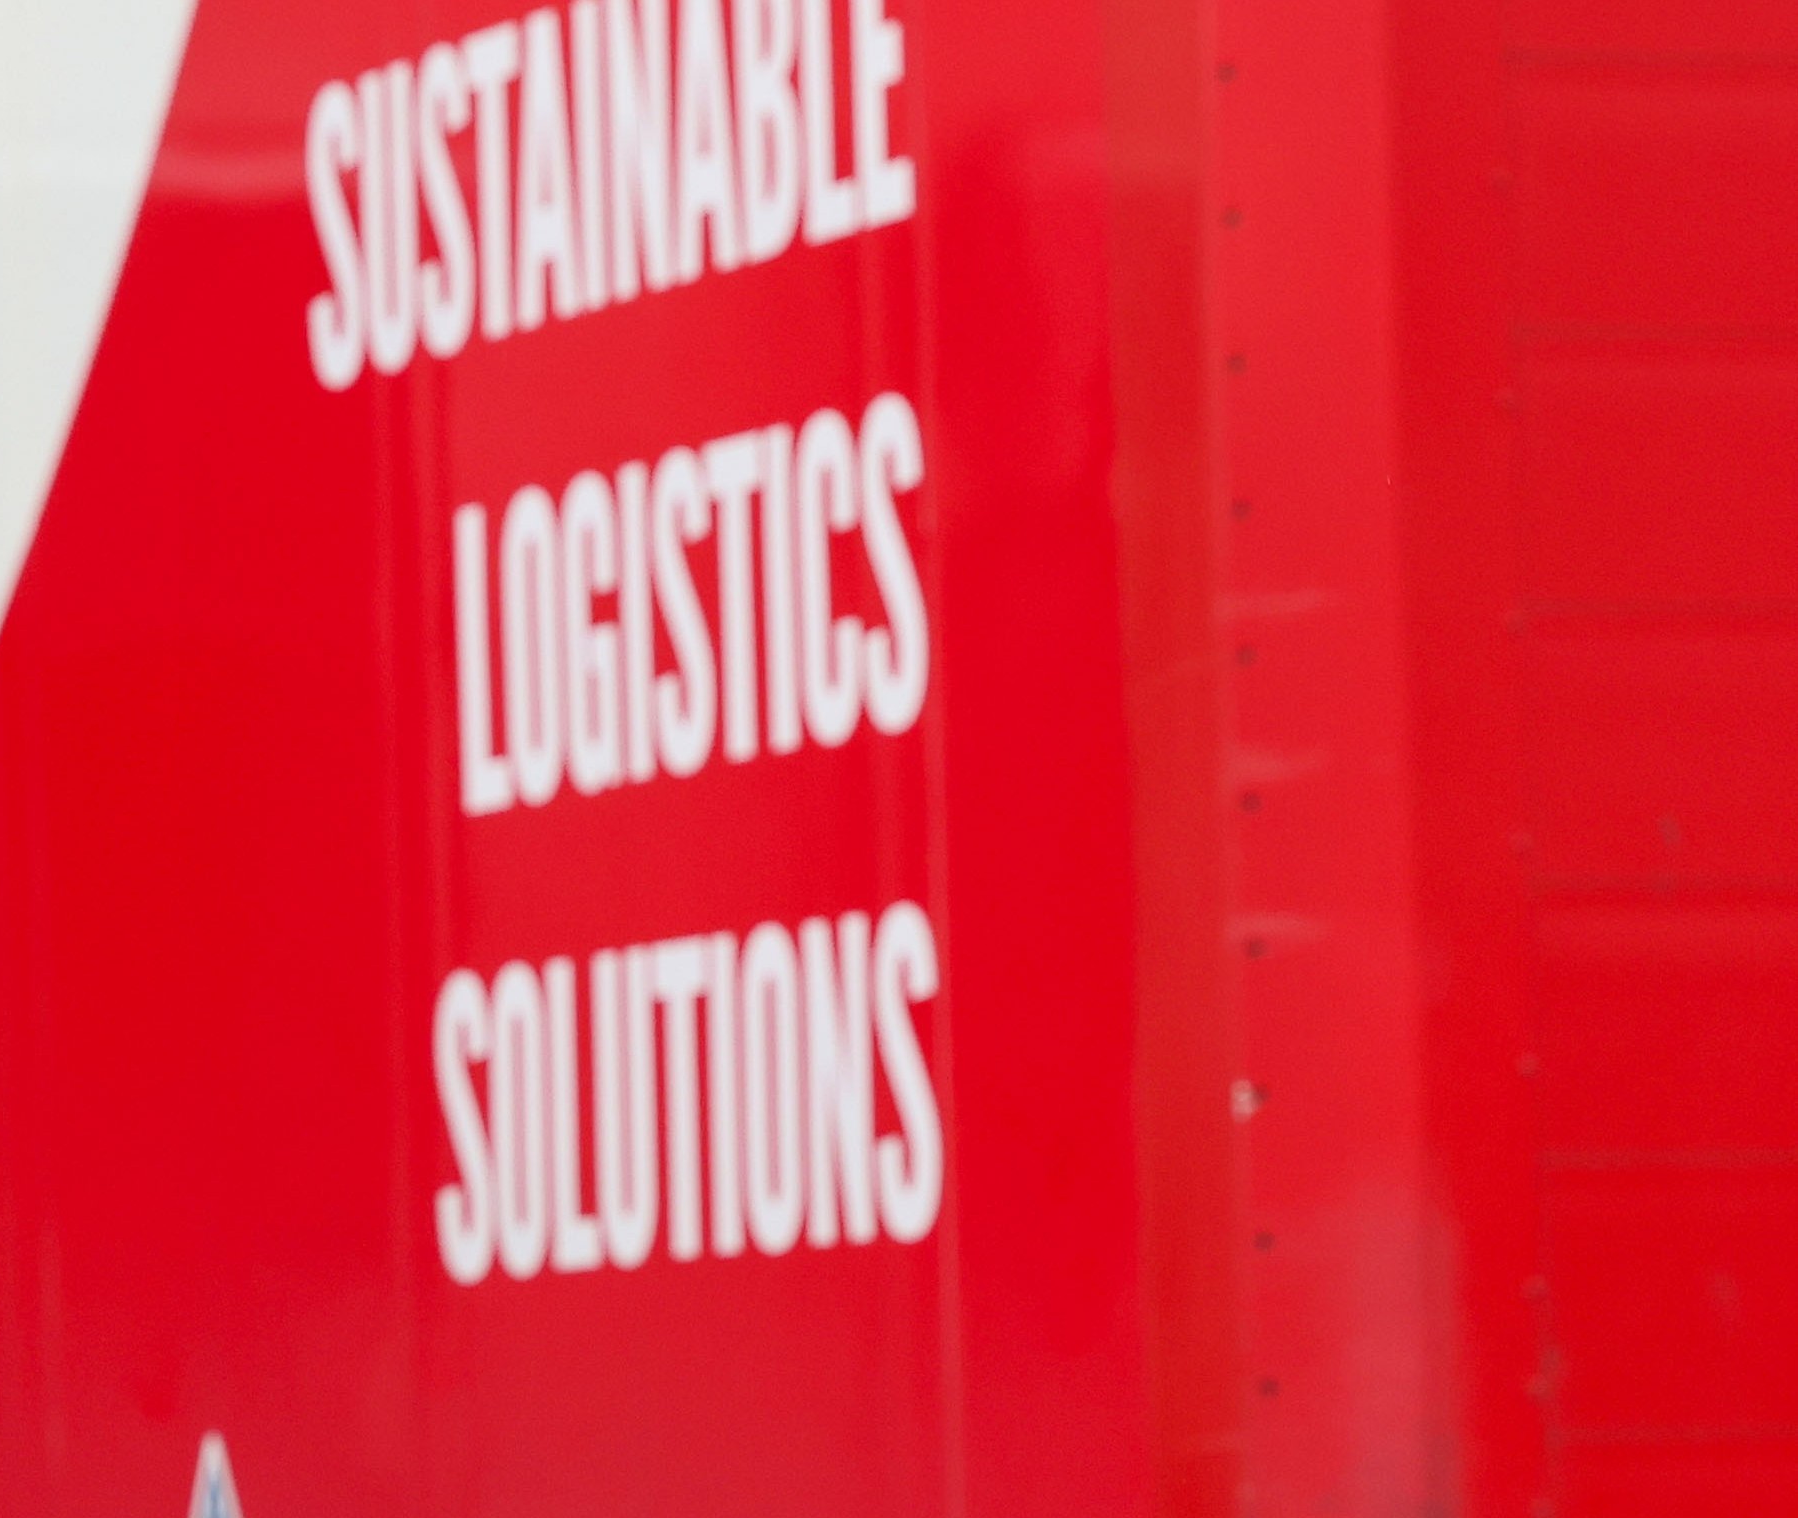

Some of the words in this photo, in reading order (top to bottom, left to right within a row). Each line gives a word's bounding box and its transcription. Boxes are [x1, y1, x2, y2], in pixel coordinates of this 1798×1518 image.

[305, 0, 916, 391] SUSTAINABLE
[453, 393, 929, 816] LOGISTICS
[433, 901, 943, 1285] SOLUTIONS
